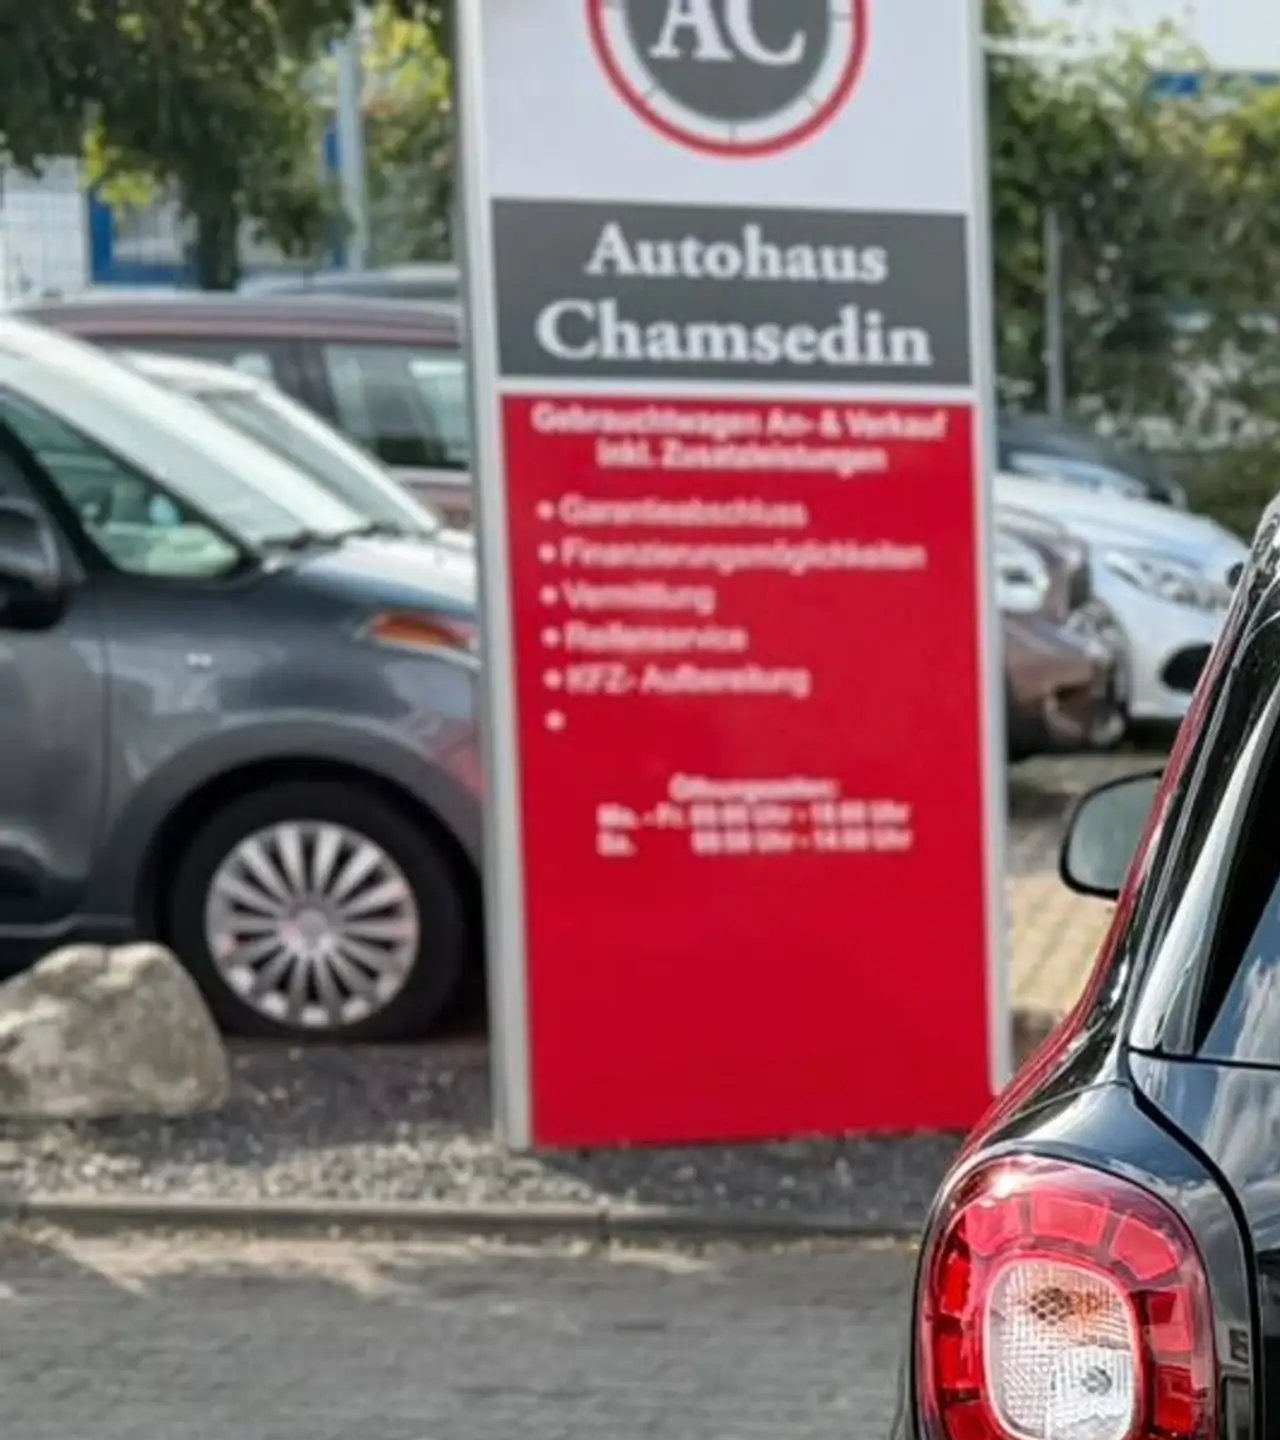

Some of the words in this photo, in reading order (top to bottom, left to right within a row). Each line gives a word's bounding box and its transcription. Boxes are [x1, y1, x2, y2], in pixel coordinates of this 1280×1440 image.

[648, 0, 806, 66] AC
[583, 220, 888, 284] Autohaus
[536, 298, 932, 366] Chamsedin
